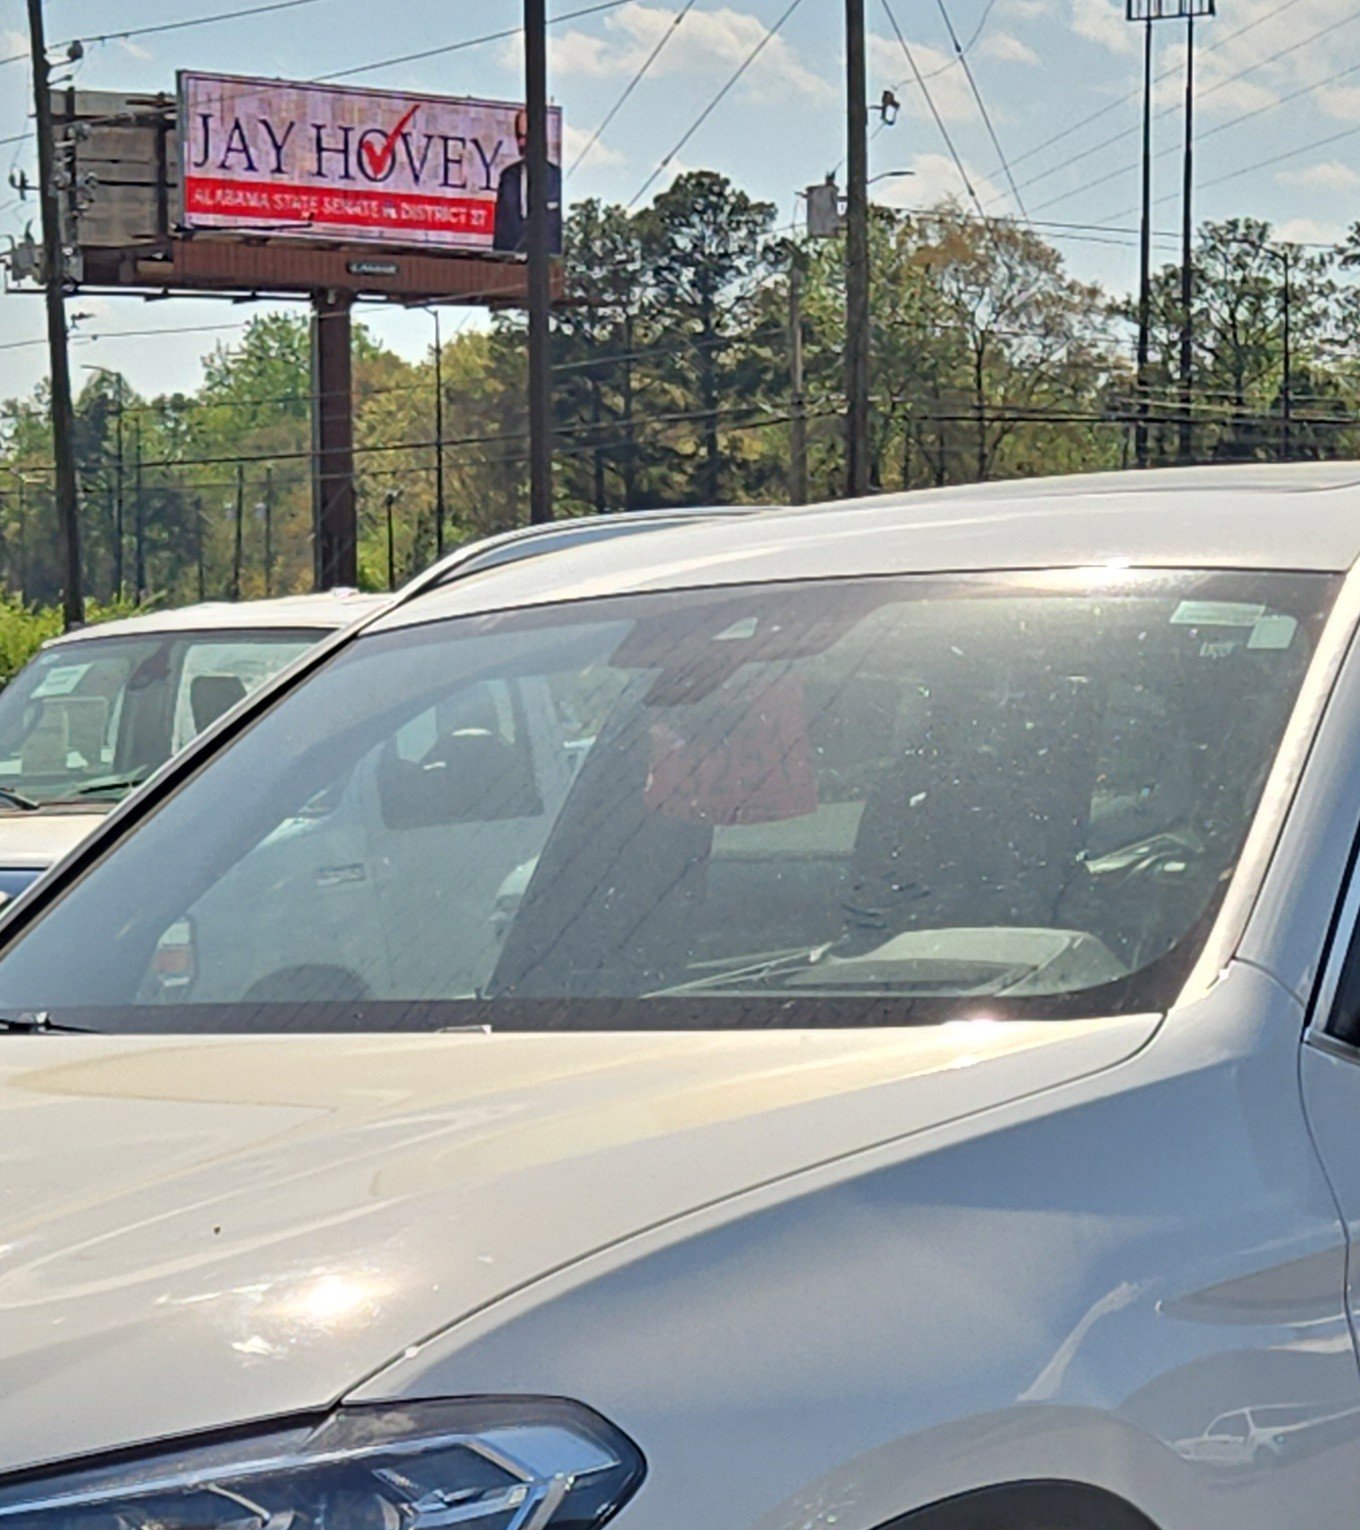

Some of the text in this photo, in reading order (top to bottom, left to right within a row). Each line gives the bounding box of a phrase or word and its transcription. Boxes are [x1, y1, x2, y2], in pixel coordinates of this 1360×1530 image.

[194, 112, 503, 191] JAY HOVEY
[400, 202, 467, 224] DISTRICT
